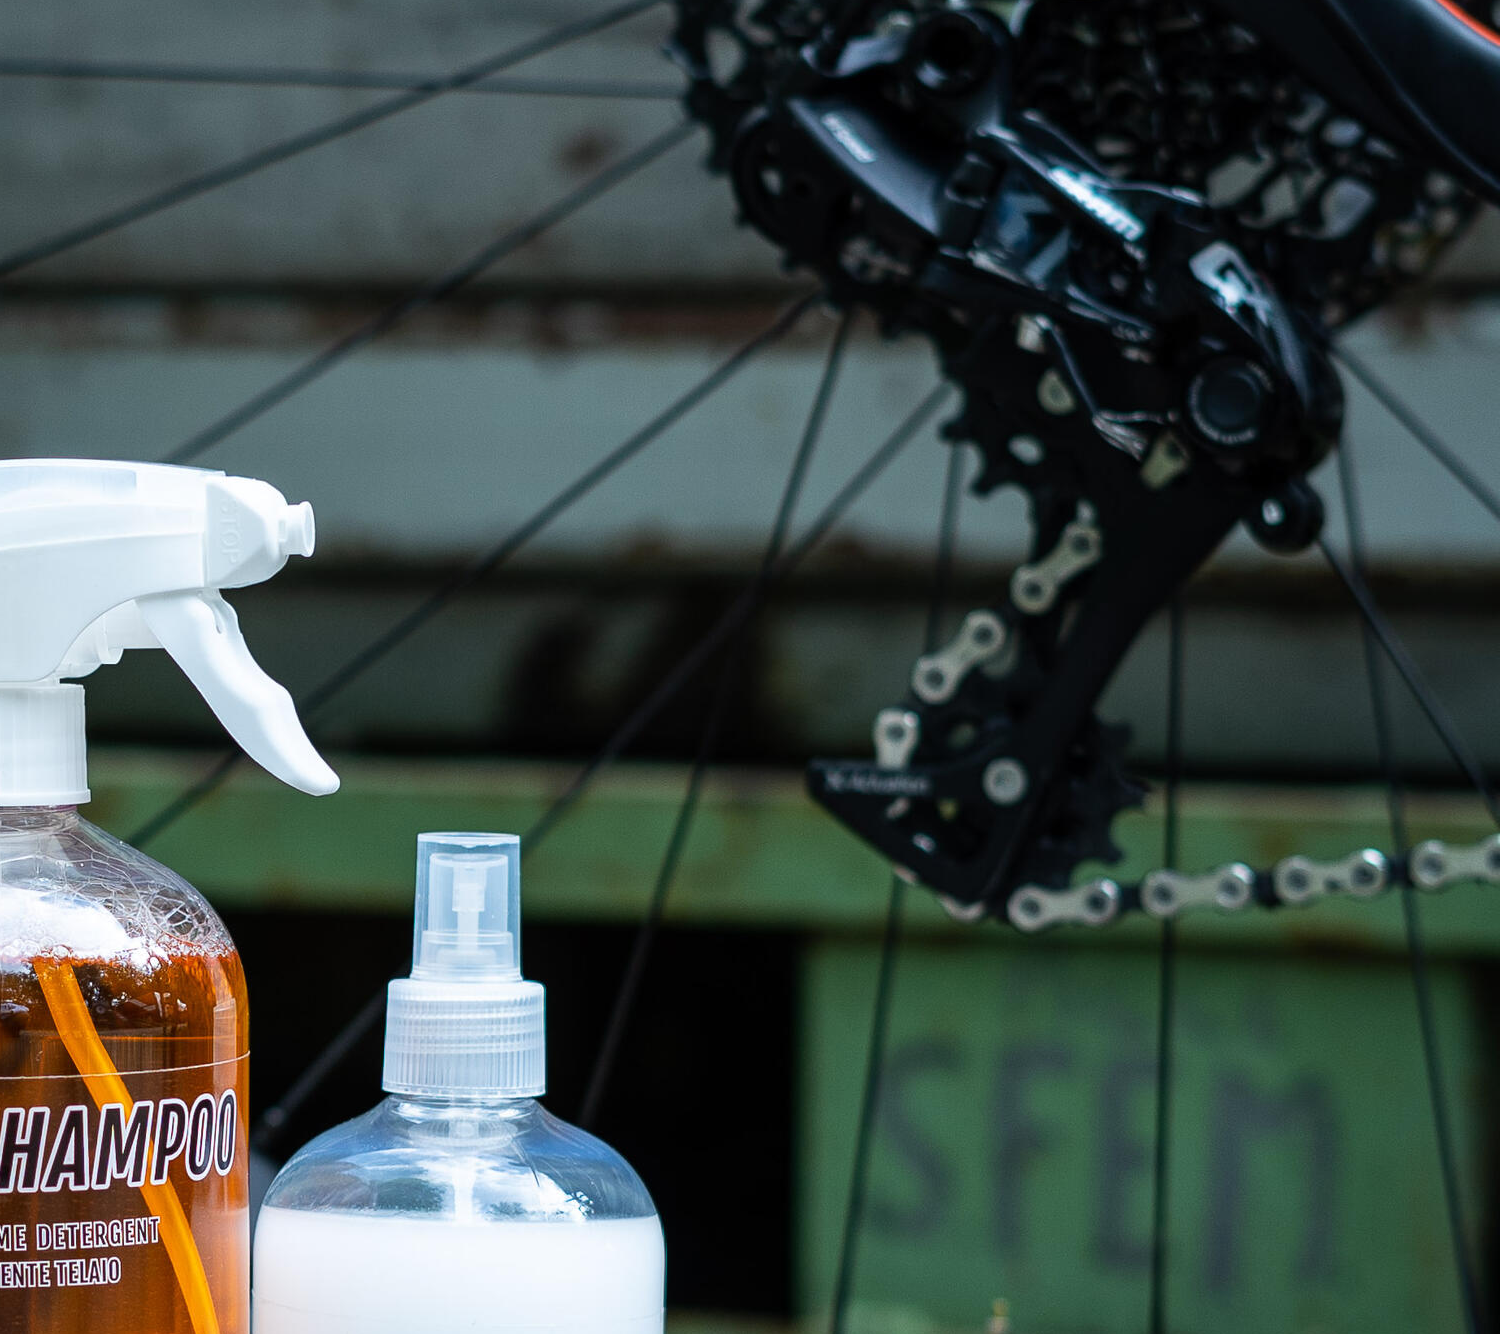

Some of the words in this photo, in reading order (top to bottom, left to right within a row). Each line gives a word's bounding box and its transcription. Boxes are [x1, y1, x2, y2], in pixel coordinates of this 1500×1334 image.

[220, 498, 241, 565] STOP
[36, 1216, 161, 1251] DETERGENT
[54, 1256, 122, 1286] TELAIO
